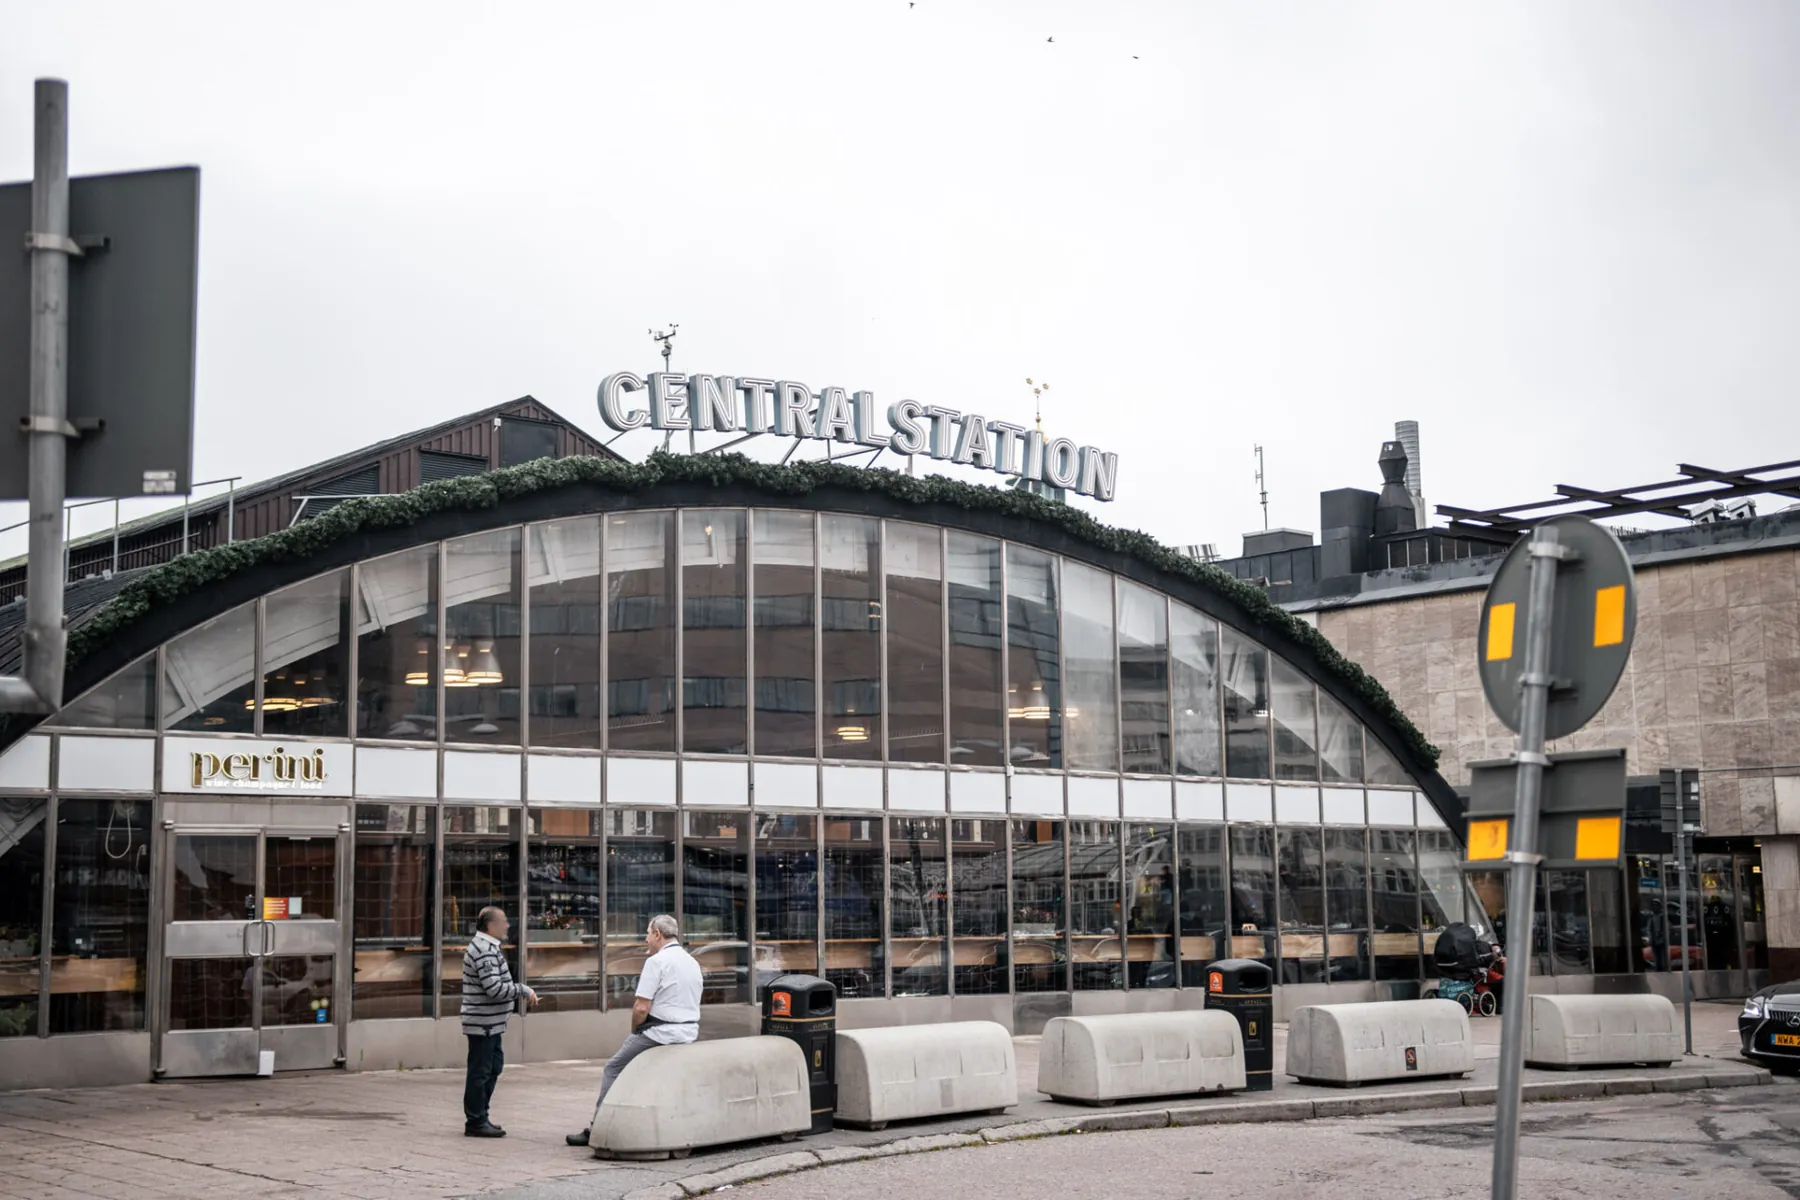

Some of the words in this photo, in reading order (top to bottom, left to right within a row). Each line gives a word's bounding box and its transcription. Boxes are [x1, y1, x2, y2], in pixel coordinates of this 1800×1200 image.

[191, 746, 328, 788] perini
[205, 779, 229, 787] wine
[232, 780, 289, 790] champagne
[300, 781, 322, 789] food
